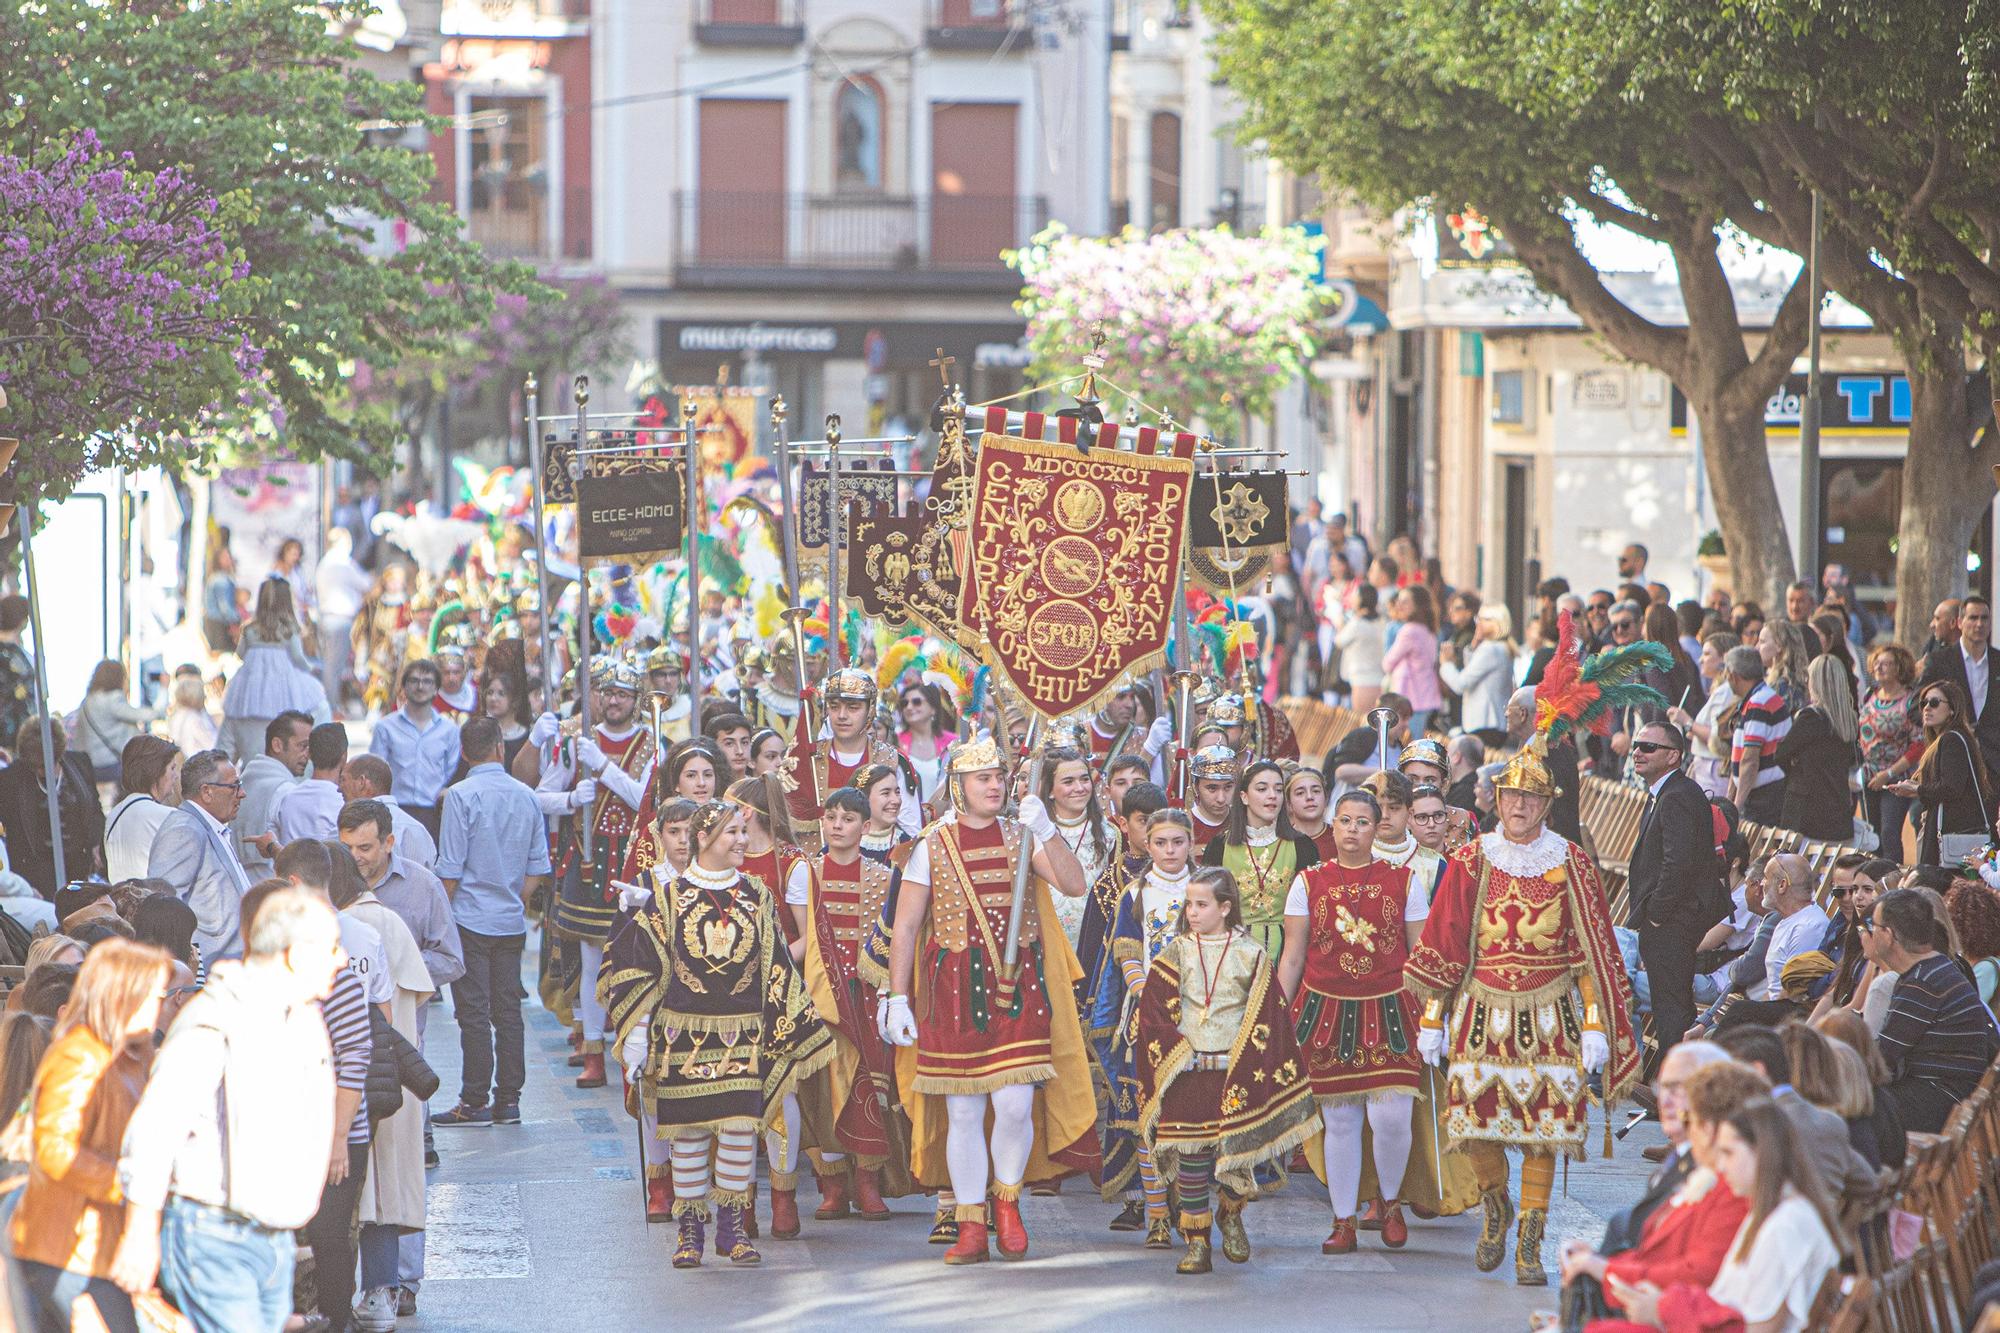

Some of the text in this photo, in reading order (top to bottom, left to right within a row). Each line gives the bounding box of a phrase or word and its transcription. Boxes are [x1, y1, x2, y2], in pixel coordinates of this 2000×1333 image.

[1023, 455, 1150, 486] MDCCCXCI
[592, 504, 673, 523] ECCE-HOMO
[971, 461, 1012, 621] CENTURIA
[998, 632, 1122, 702] ORIHUELA
